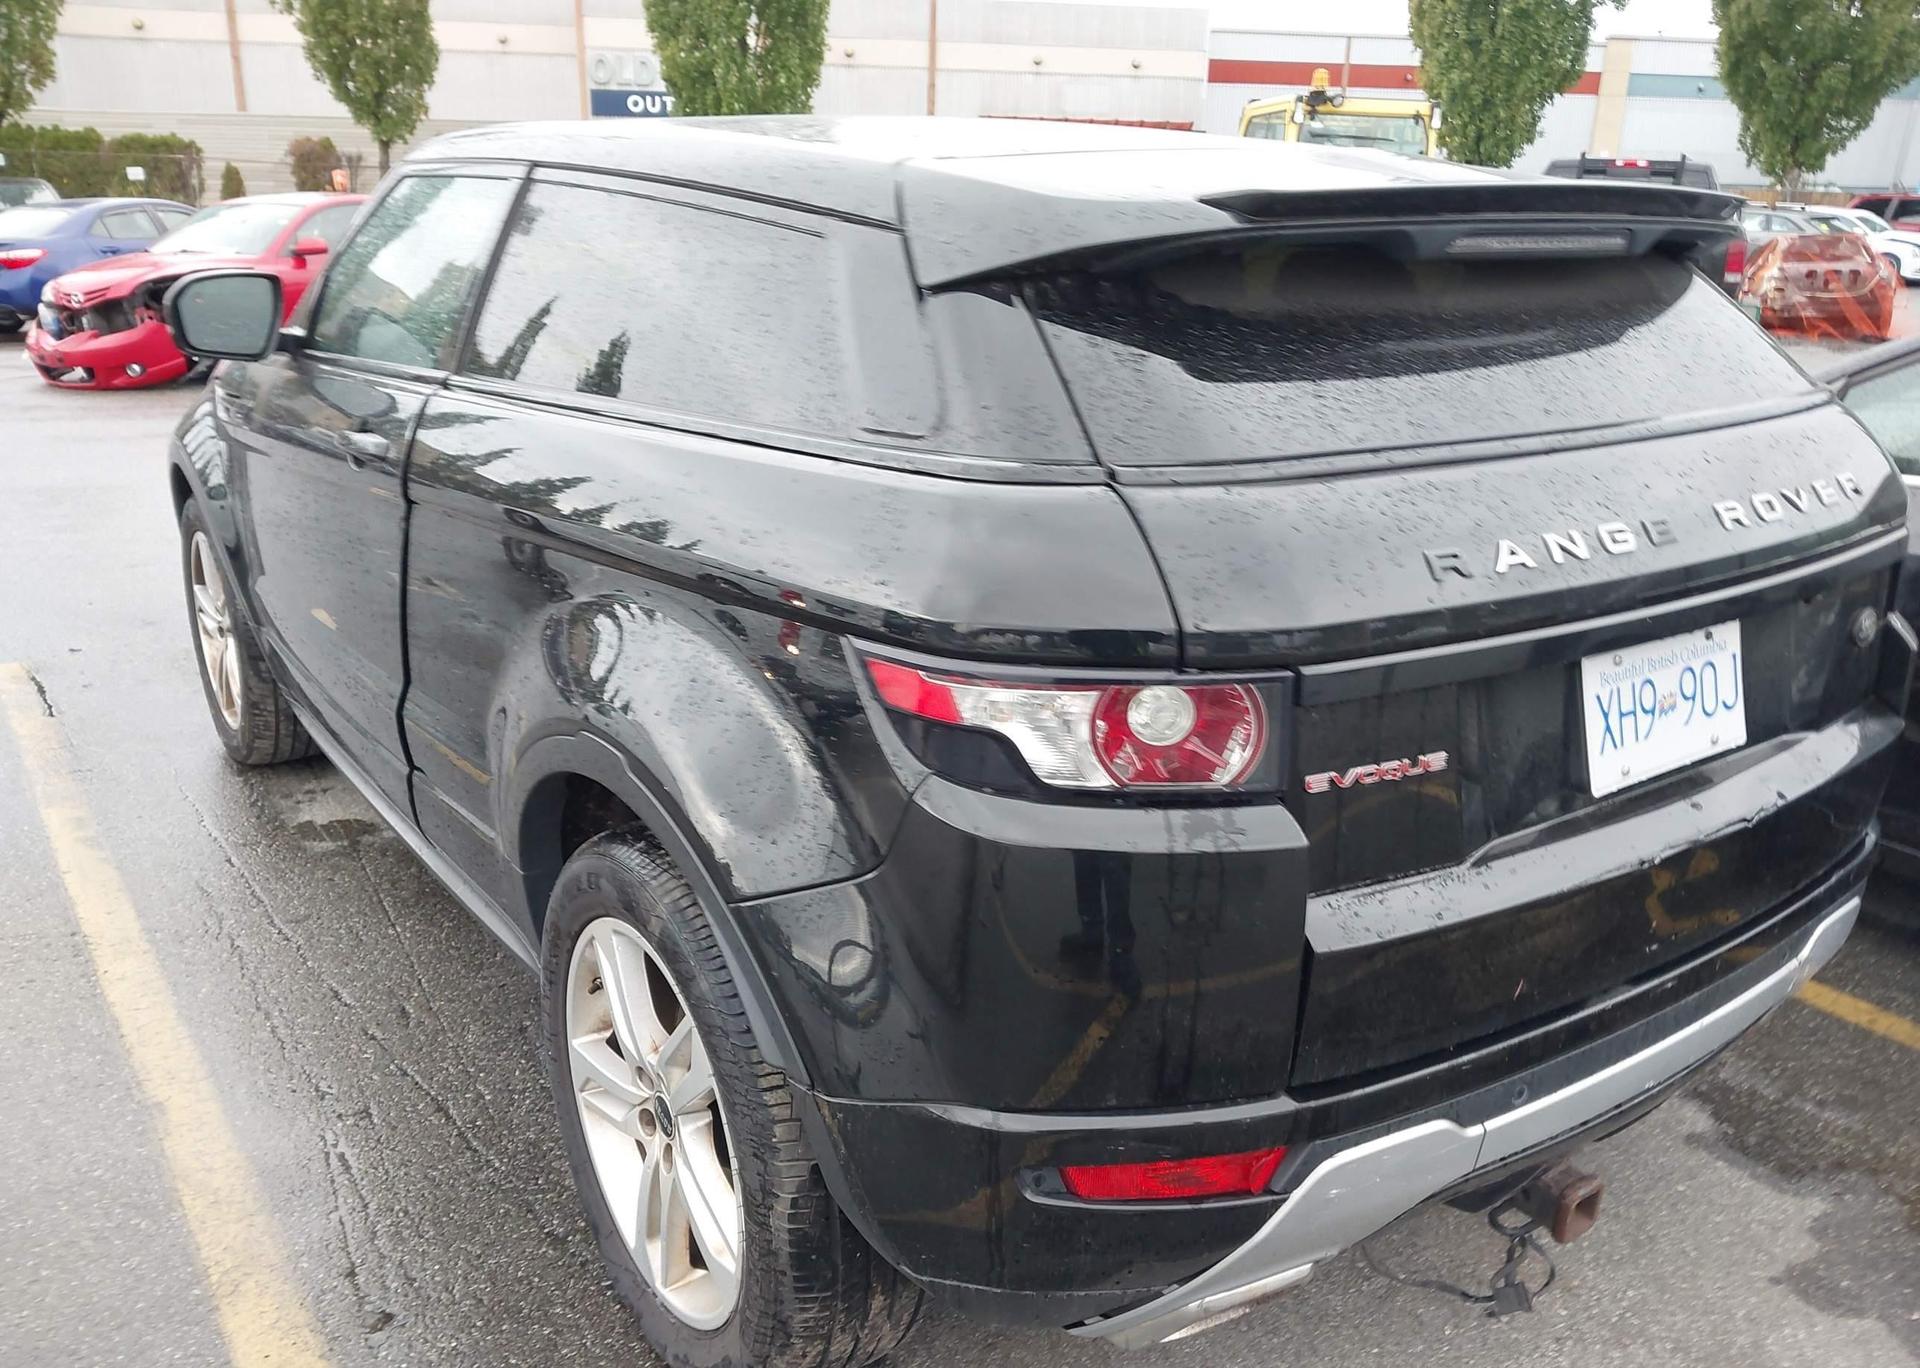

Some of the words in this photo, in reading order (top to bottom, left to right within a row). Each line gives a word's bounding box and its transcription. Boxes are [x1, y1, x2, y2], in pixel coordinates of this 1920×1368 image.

[590, 53, 656, 86] OLD
[1424, 518, 1678, 583] RANGE
[1713, 471, 1864, 531] ROVER
[1600, 658, 1645, 687] Beautiful
[1648, 650, 1678, 673] British
[1680, 639, 1727, 663] Columbia
[1595, 677, 1657, 756] XH9
[1679, 653, 1738, 726] 90J
[1304, 750, 1449, 794] EVOQUE
